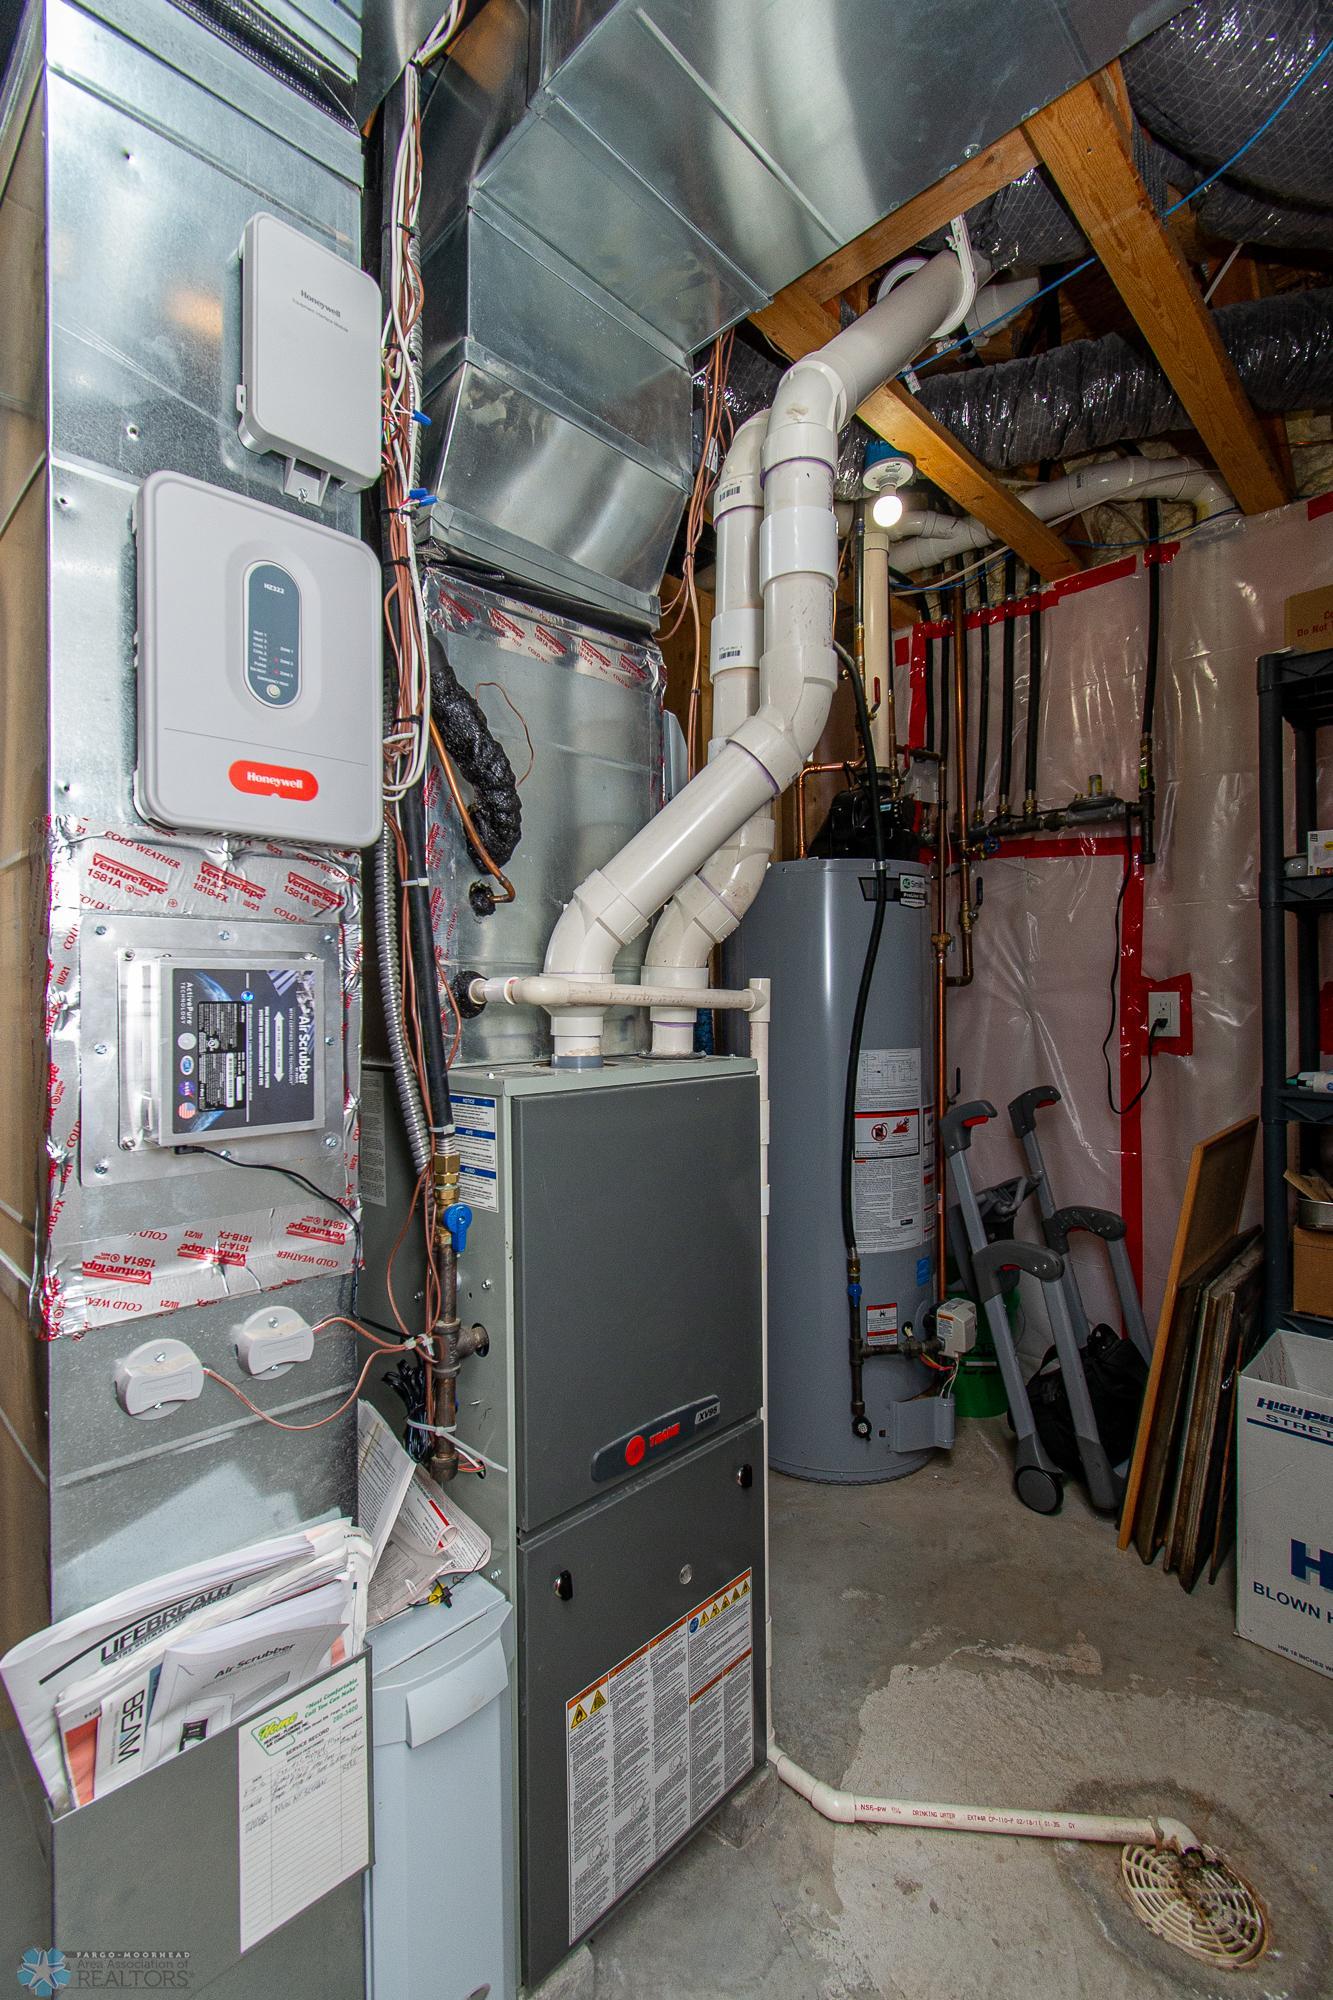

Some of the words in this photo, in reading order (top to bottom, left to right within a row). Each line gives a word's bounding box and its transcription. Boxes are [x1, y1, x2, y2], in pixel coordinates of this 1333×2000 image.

[300, 289, 341, 318] Honeywell
[246, 770, 303, 790] Honeywell
[135, 843, 181, 869] WEATHER
[87, 868, 121, 889] 1581A
[192, 882, 230, 904] 181B-FX
[283, 884, 311, 904] 1581A
[298, 1015, 311, 1033] Air
[298, 1034, 311, 1085] Scrubber
[322, 1217, 349, 1231] 1581A
[217, 1230, 253, 1243] 181B-FX
[123, 1254, 157, 1269] 1581A
[276, 1250, 316, 1264] WEATHER
[315, 1256, 339, 1269] COLD
[112, 1299, 143, 1312] COLD
[1253, 1581, 1321, 1619] BLOWN
[101, 1582, 234, 1662] LIFEBREATH
[118, 1688, 145, 1764] BEAM
[912, 1808, 938, 1818] DRINKING
[939, 1811, 956, 1820] WATER
